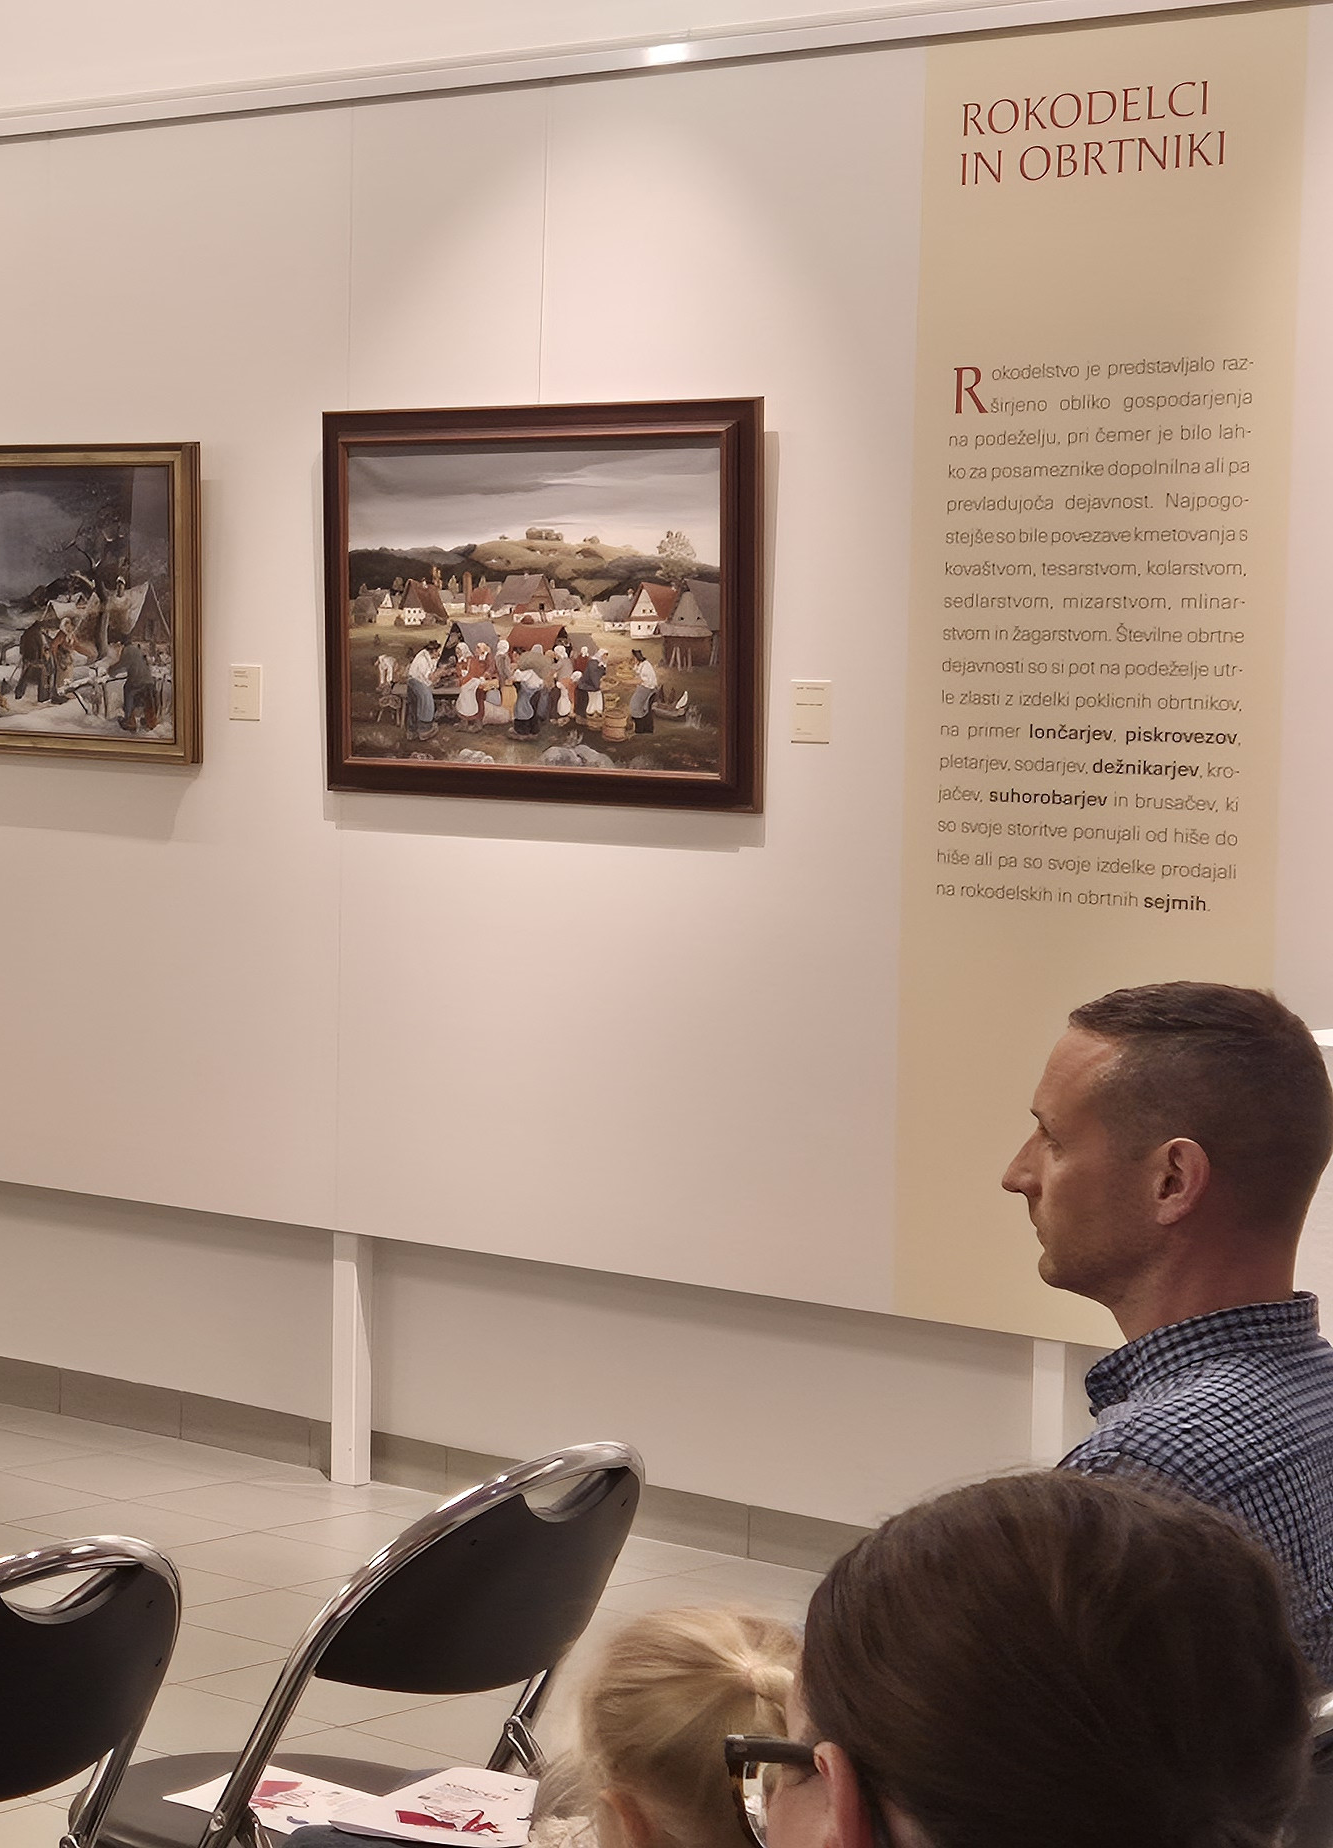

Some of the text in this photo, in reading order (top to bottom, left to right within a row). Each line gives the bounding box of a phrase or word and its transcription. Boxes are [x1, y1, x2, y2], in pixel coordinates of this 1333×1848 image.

[962, 80, 1210, 136] ROKODELCI
[960, 130, 1227, 186] IN OBRTNIKI
[1085, 361, 1100, 381] je
[1108, 356, 1215, 379] predstavljalo
[1060, 394, 1110, 412] obliko
[1124, 389, 1252, 414] gospodarjenja
[949, 435, 968, 447] na
[1068, 427, 1088, 447] pri
[1158, 425, 1173, 445] je
[1181, 424, 1211, 440] bilo
[948, 456, 1249, 482] ko za posameznike dopolnilna ali pa
[997, 531, 1016, 543] so
[1018, 526, 1049, 544] bile
[1050, 530, 1132, 546] povezave
[1133, 524, 1236, 545] kmetovanja
[1238, 528, 1248, 541] s
[943, 626, 990, 640] stvom
[995, 625, 1008, 640] in
[1187, 627, 1244, 643] obrtne
[942, 657, 1024, 676] dejavnosti
[1028, 661, 1047, 675] so
[1051, 659, 1064, 674] si
[1069, 662, 1095, 679] pot
[1100, 663, 1120, 678] na
[942, 690, 954, 704] le
[960, 689, 1000, 706] zlasti
[1005, 694, 1013, 706] z
[1019, 691, 1069, 707] izdelki
[1075, 692, 1151, 711] poklicnih
[941, 725, 959, 737] na
[968, 722, 1021, 740] primer
[989, 786, 1107, 810] suhorobarjev
[1114, 791, 1128, 807] in
[1226, 796, 1239, 813] ki
[938, 820, 956, 832] so
[961, 819, 1002, 838] svoje
[1005, 821, 1067, 838] storitve
[1073, 825, 1140, 844] ponujali
[1146, 828, 1167, 843] od
[1215, 830, 1237, 846] do
[975, 851, 992, 866] ali
[998, 855, 1017, 870] pa
[1024, 857, 1042, 870] so
[1048, 856, 1091, 875] svoje
[1097, 857, 1155, 876] izdelke
[1161, 863, 1236, 883] prodajali
[937, 882, 955, 896] na
[961, 880, 1052, 901] rokodelskih
[1058, 887, 1072, 903] in
[1078, 890, 1138, 907] obrtnih
